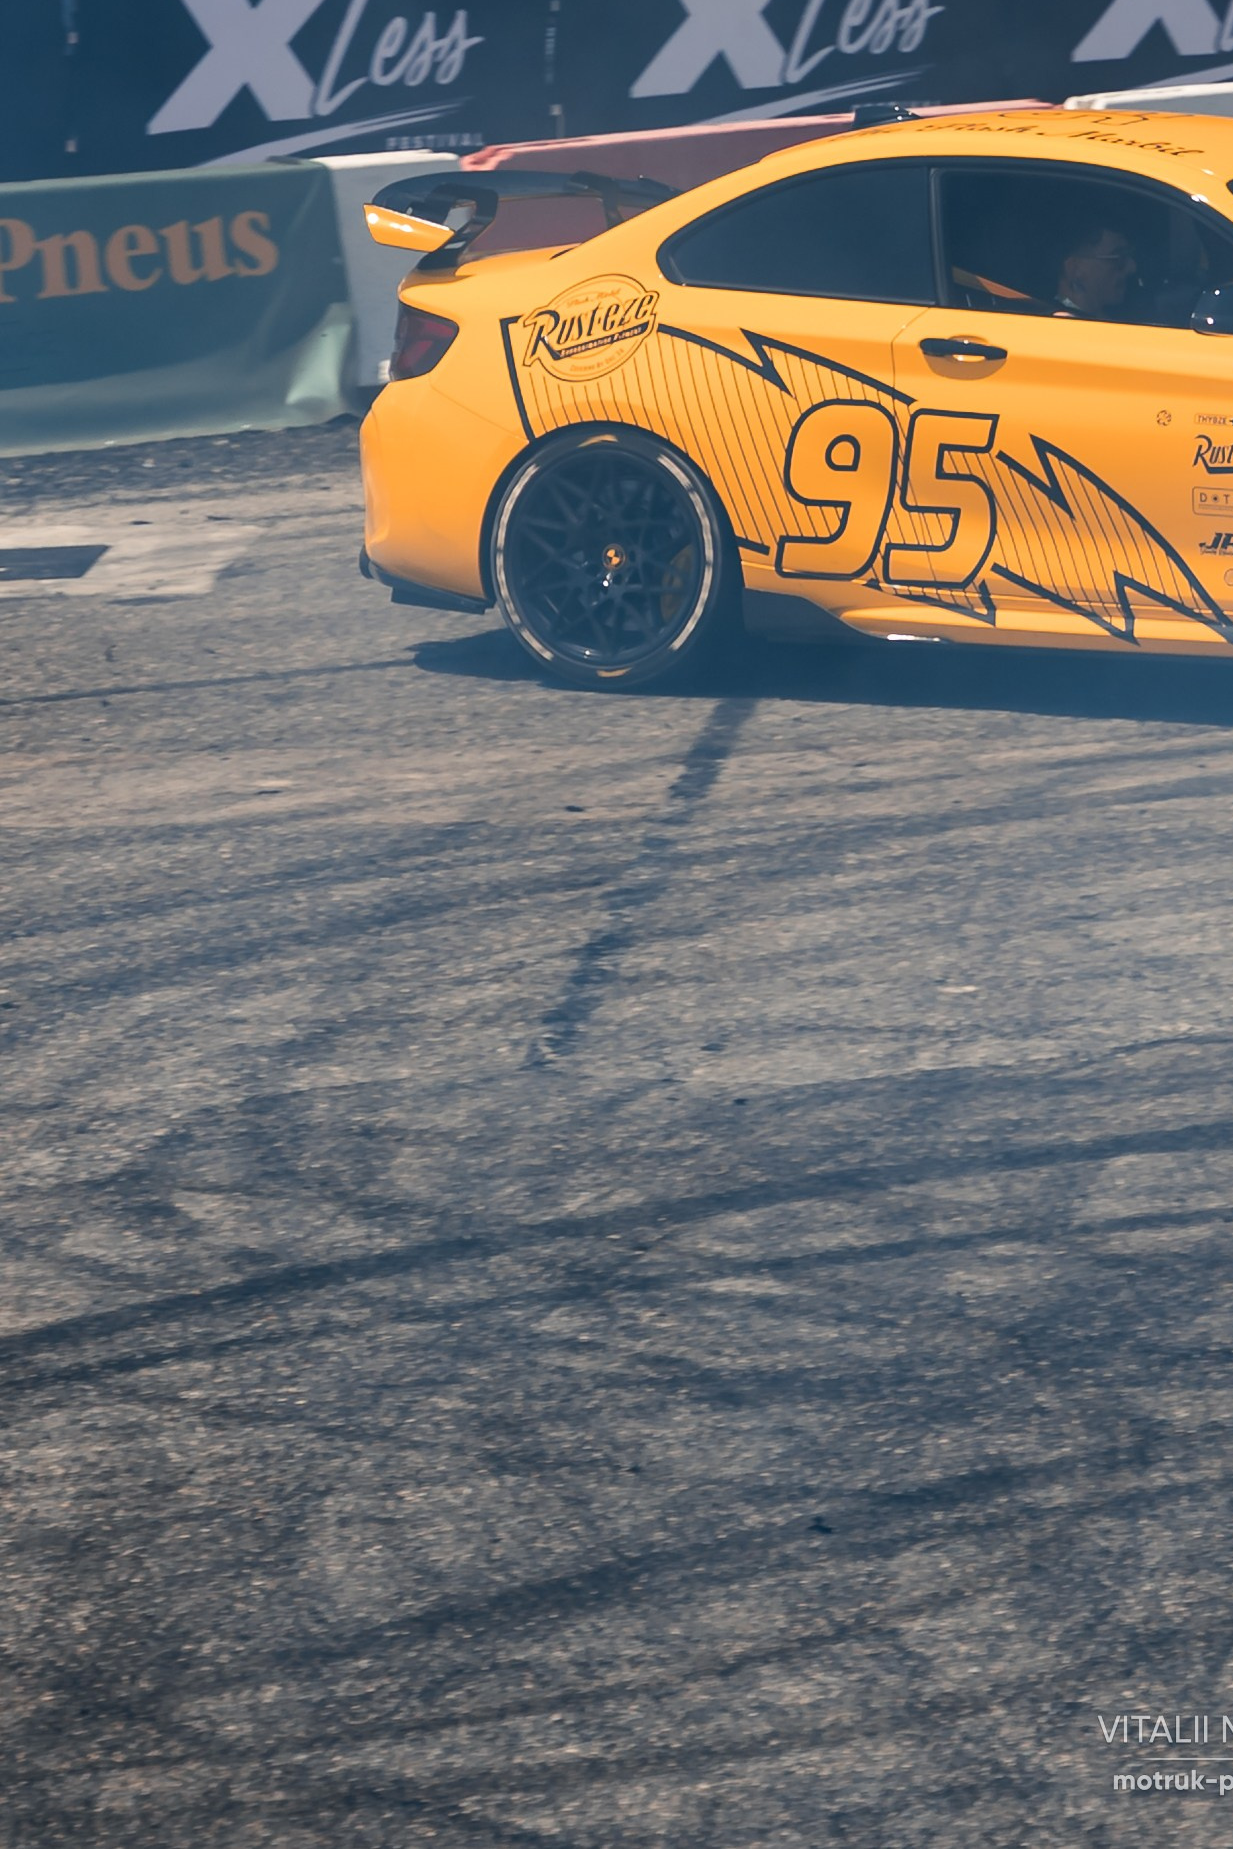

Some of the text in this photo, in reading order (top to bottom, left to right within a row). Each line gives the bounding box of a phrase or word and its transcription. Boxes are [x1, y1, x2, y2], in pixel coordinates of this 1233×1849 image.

[386, 132, 484, 151] FESTIVAL
[0, 210, 280, 304] Pneus
[774, 398, 1000, 589] 95
